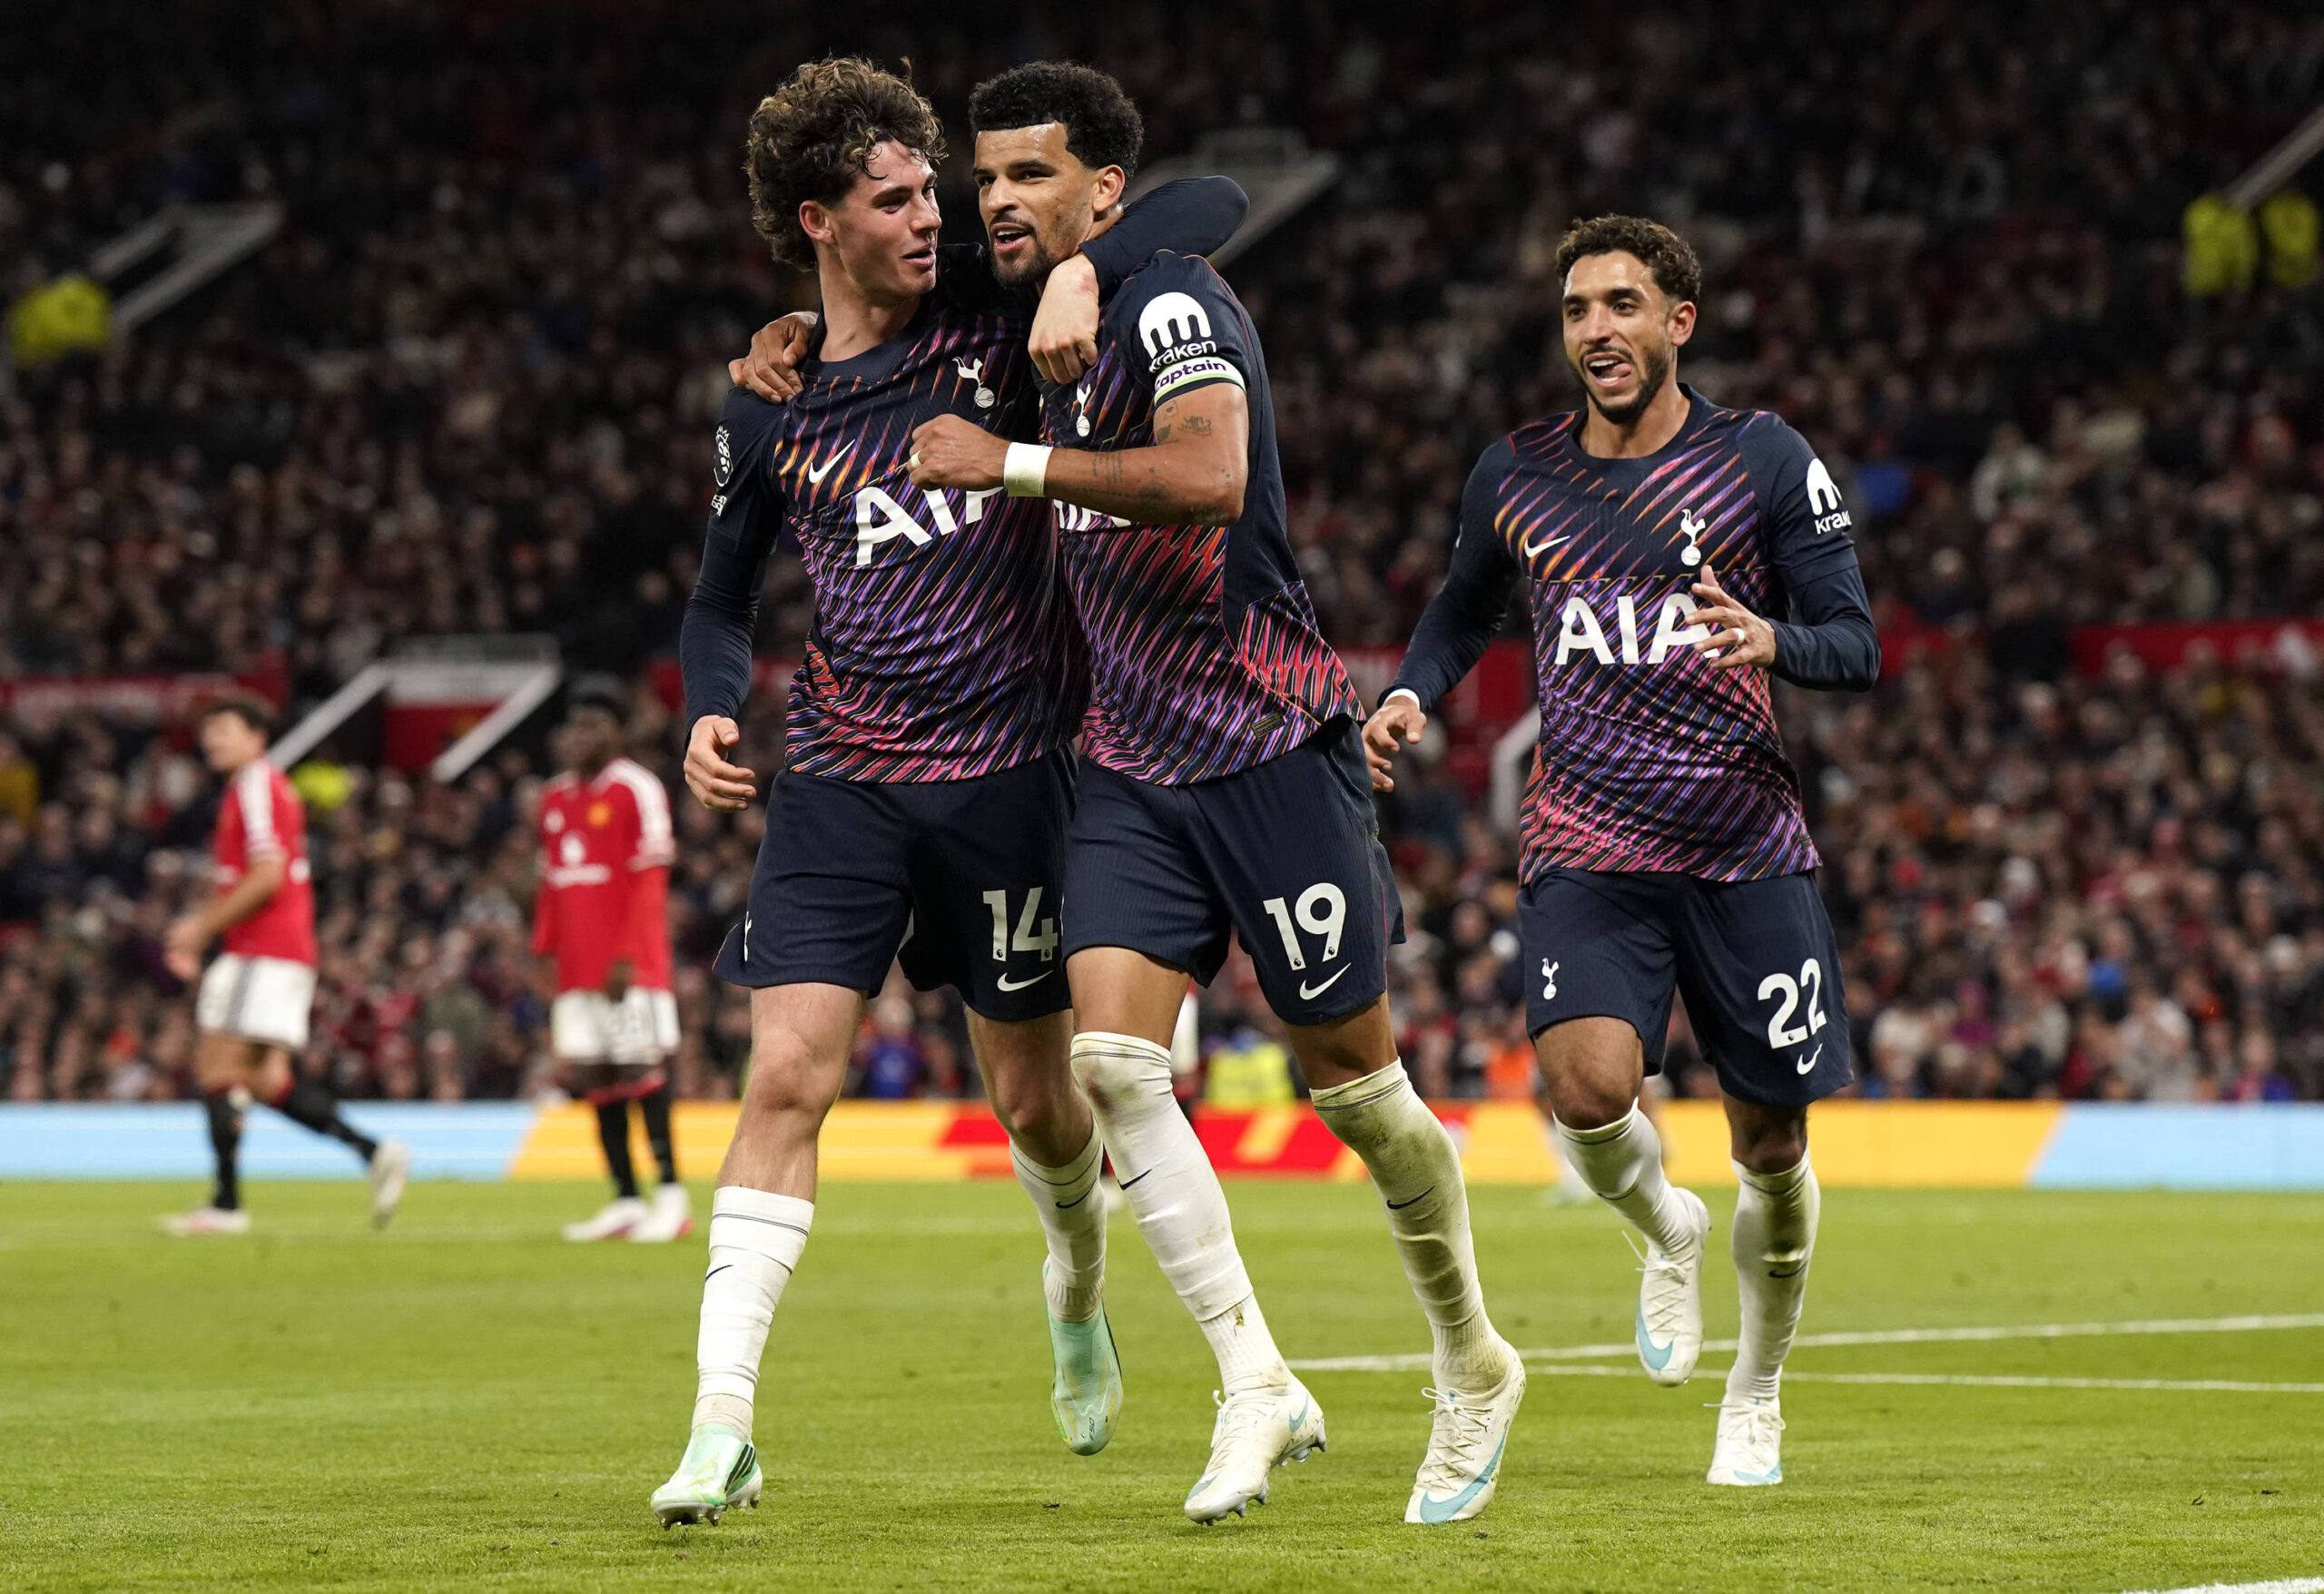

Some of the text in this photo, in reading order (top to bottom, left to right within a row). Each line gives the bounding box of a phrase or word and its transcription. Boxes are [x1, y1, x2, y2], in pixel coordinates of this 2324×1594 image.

[1148, 340, 1217, 373] kraken
[1815, 510, 1852, 535] krak
[1554, 593, 1720, 665] AIA
[983, 886, 1059, 961] 14
[1263, 882, 1346, 971] 19
[1758, 958, 1827, 1048] 22
